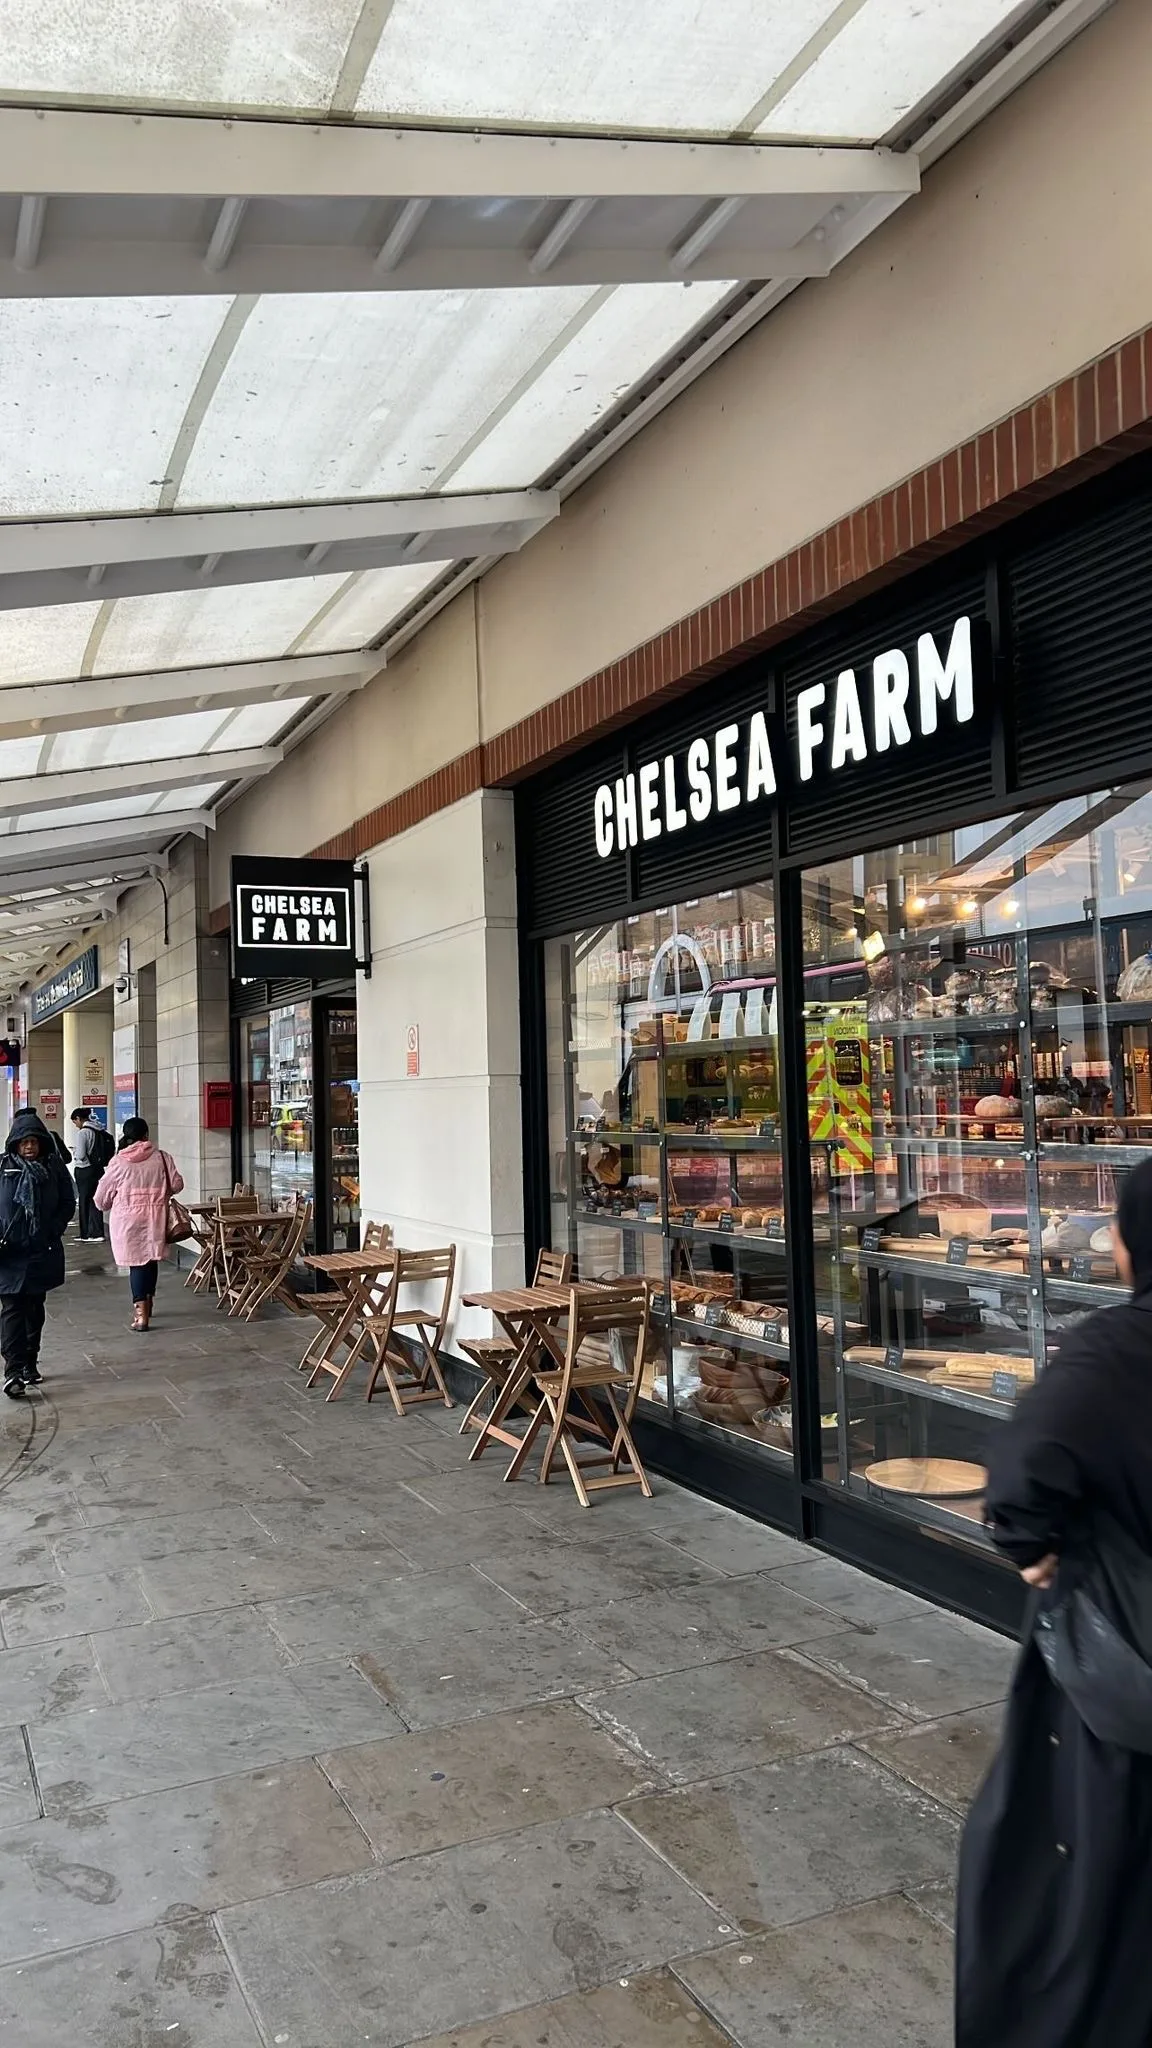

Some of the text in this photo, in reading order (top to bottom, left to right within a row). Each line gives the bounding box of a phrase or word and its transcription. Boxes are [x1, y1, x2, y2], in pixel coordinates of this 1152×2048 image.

[594, 616, 974, 858] CHELSEA FARM
[251, 894, 336, 916] CHELSEA
[252, 916, 337, 942] FARM
